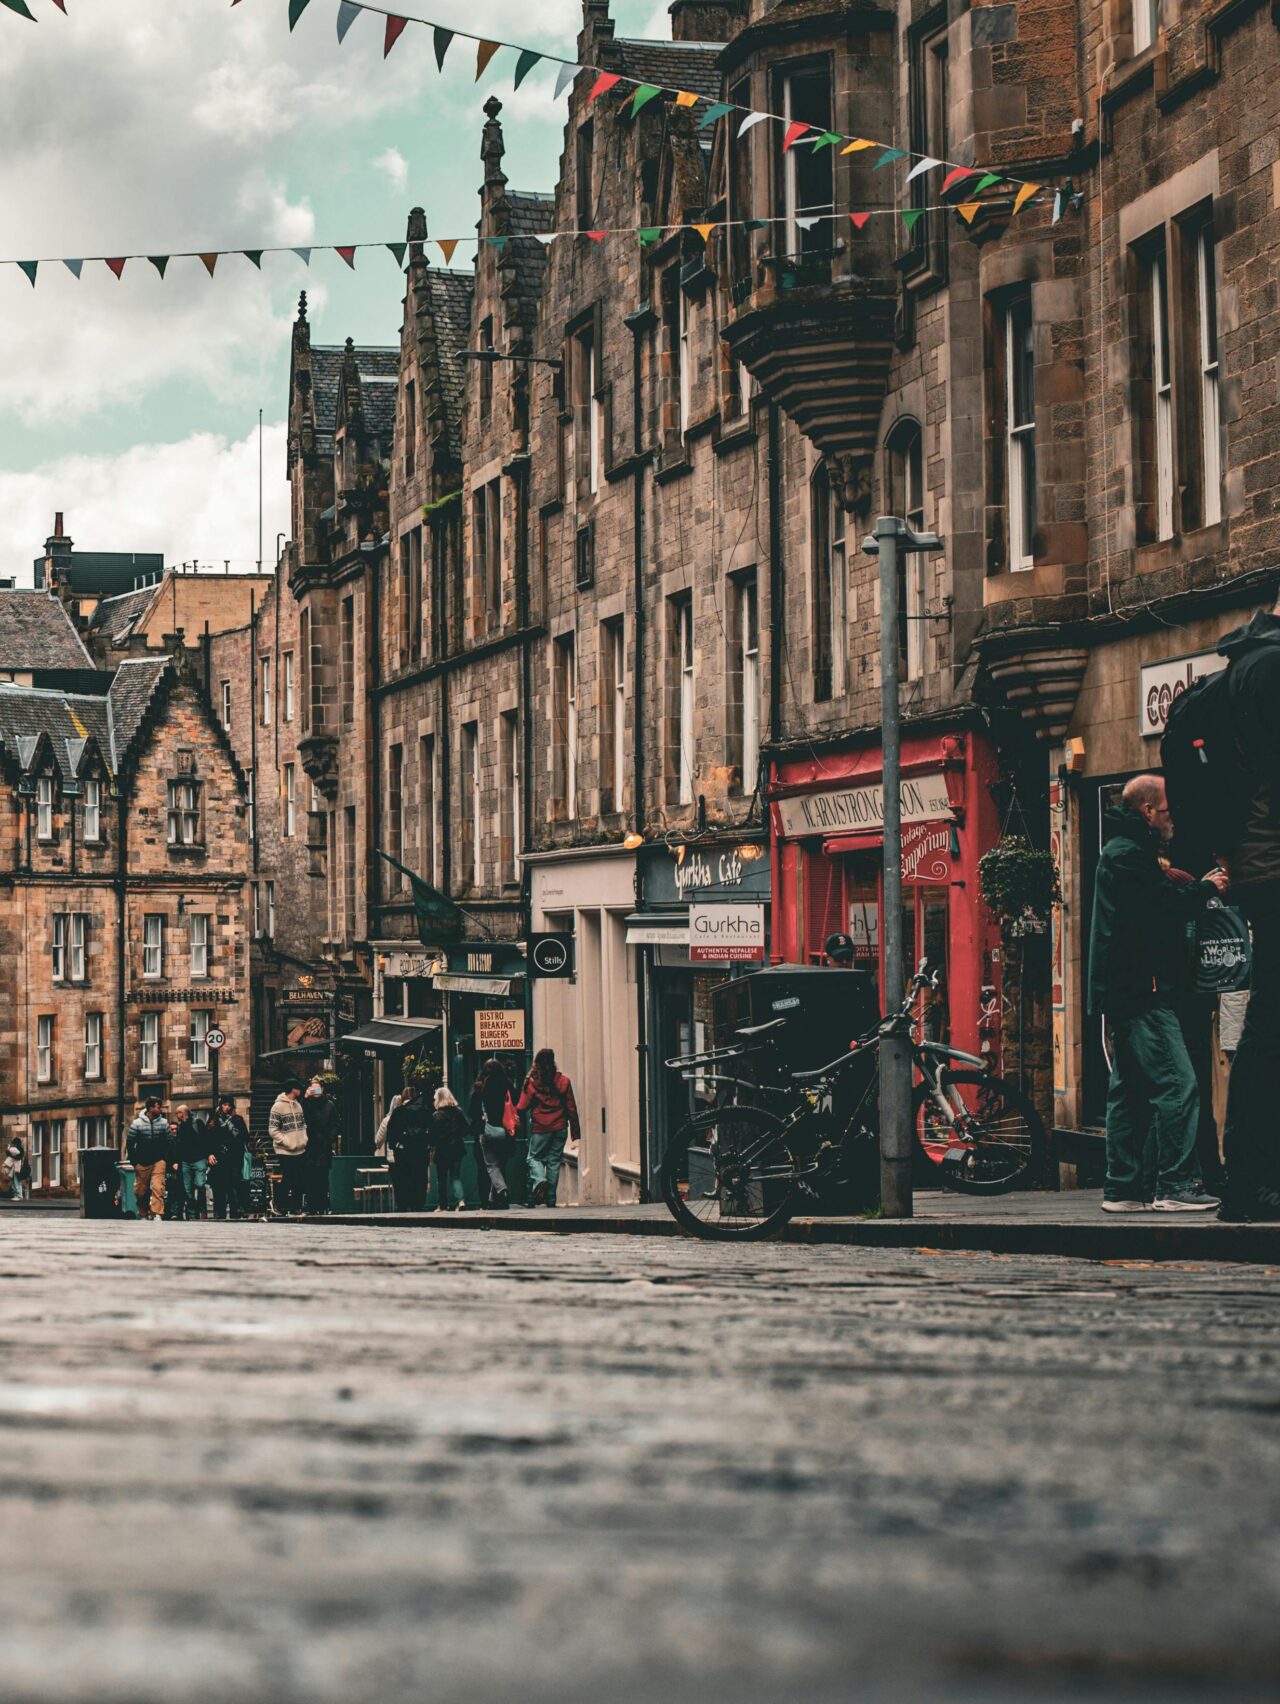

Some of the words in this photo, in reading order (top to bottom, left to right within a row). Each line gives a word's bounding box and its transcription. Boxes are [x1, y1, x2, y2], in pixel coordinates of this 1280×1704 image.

[674, 853, 712, 900] Gurkha
[695, 915, 760, 933] Gurkha
[544, 956, 563, 965] Stills
[288, 991, 323, 1000] BELHAVEN
[480, 1011, 504, 1020] BISTRO
[480, 1020, 517, 1030] BREAKFAST
[208, 1034, 223, 1043] 20
[480, 1030, 509, 1039] BURGERS
[480, 1039, 502, 1048] BAKED
[502, 1039, 524, 1048] GOODS
